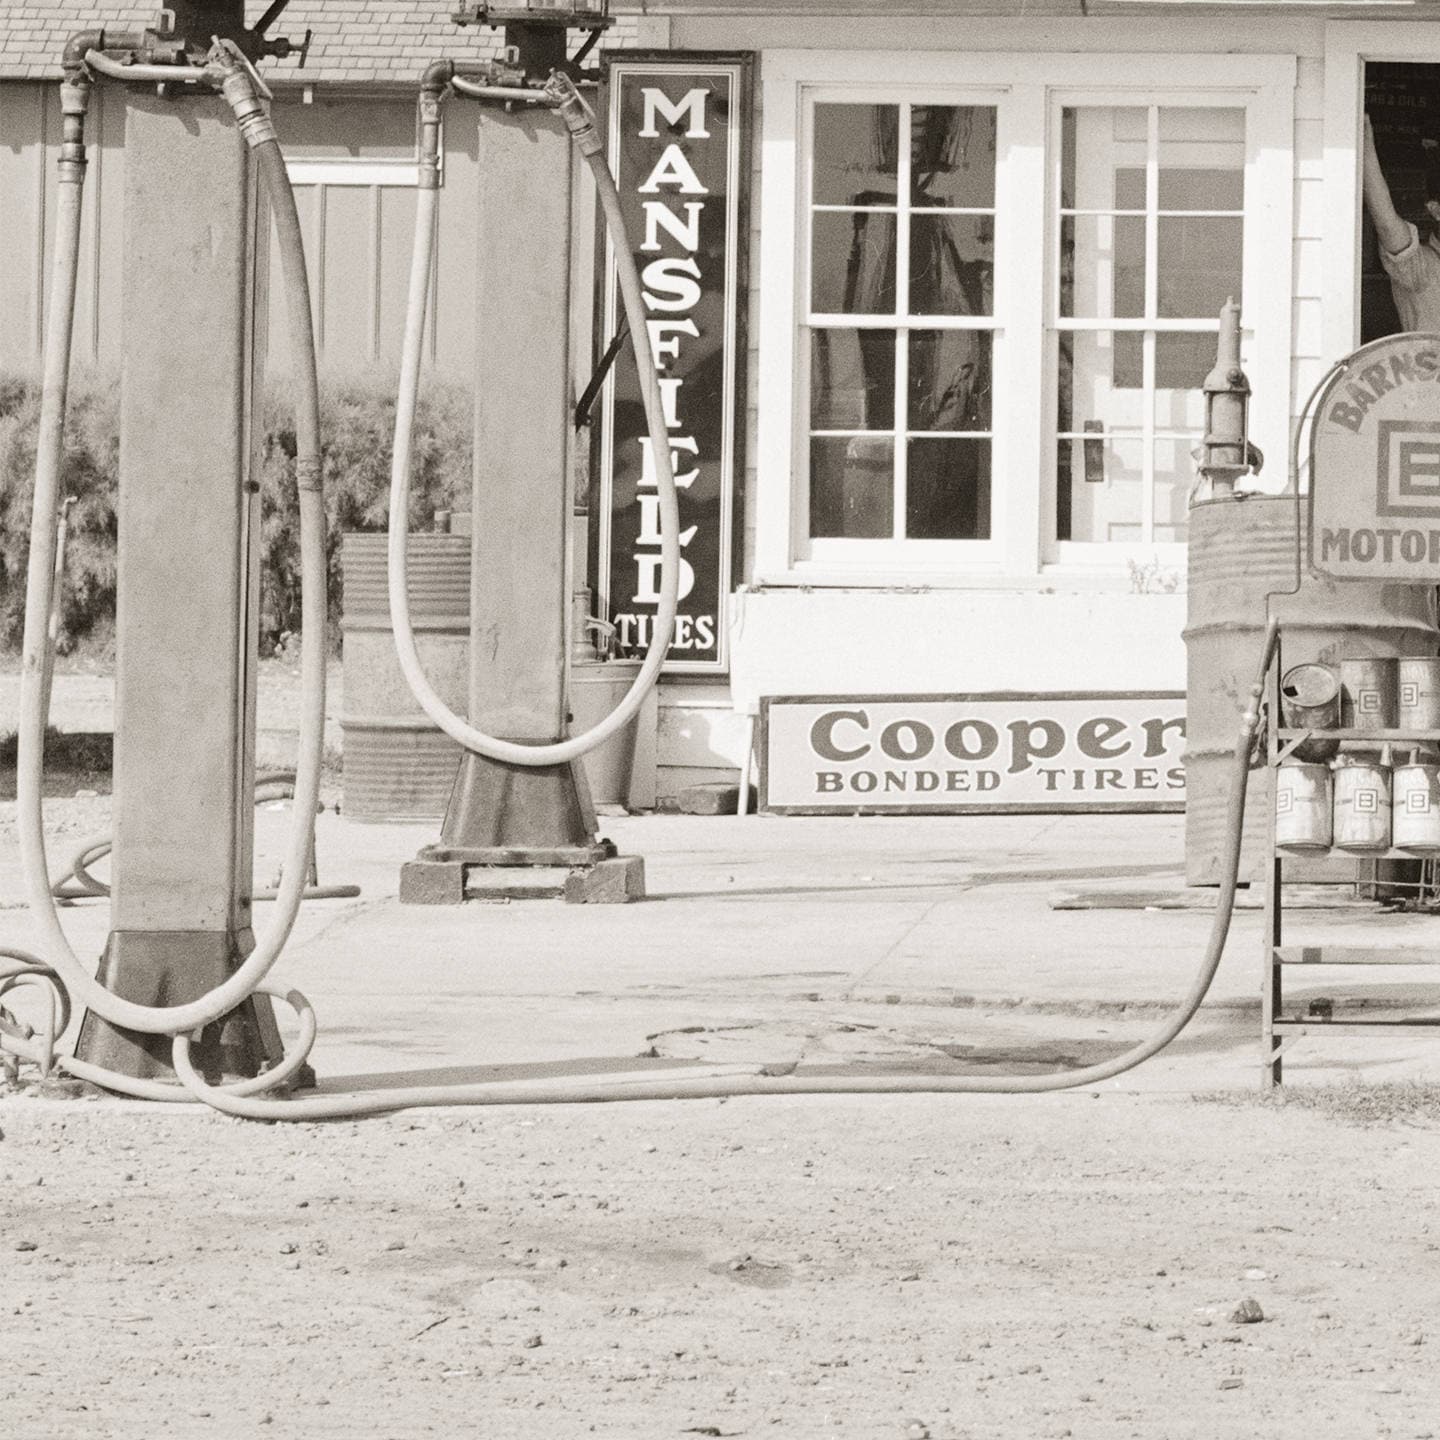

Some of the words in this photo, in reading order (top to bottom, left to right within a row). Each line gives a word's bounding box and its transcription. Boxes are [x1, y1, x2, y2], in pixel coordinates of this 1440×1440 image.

[631, 87, 711, 604] MANSFIELD
[614, 613, 715, 650] TIES
[810, 709, 1186, 775] Cooper
[815, 769, 1001, 793] BONDED
[1036, 767, 1186, 791] TIRES
